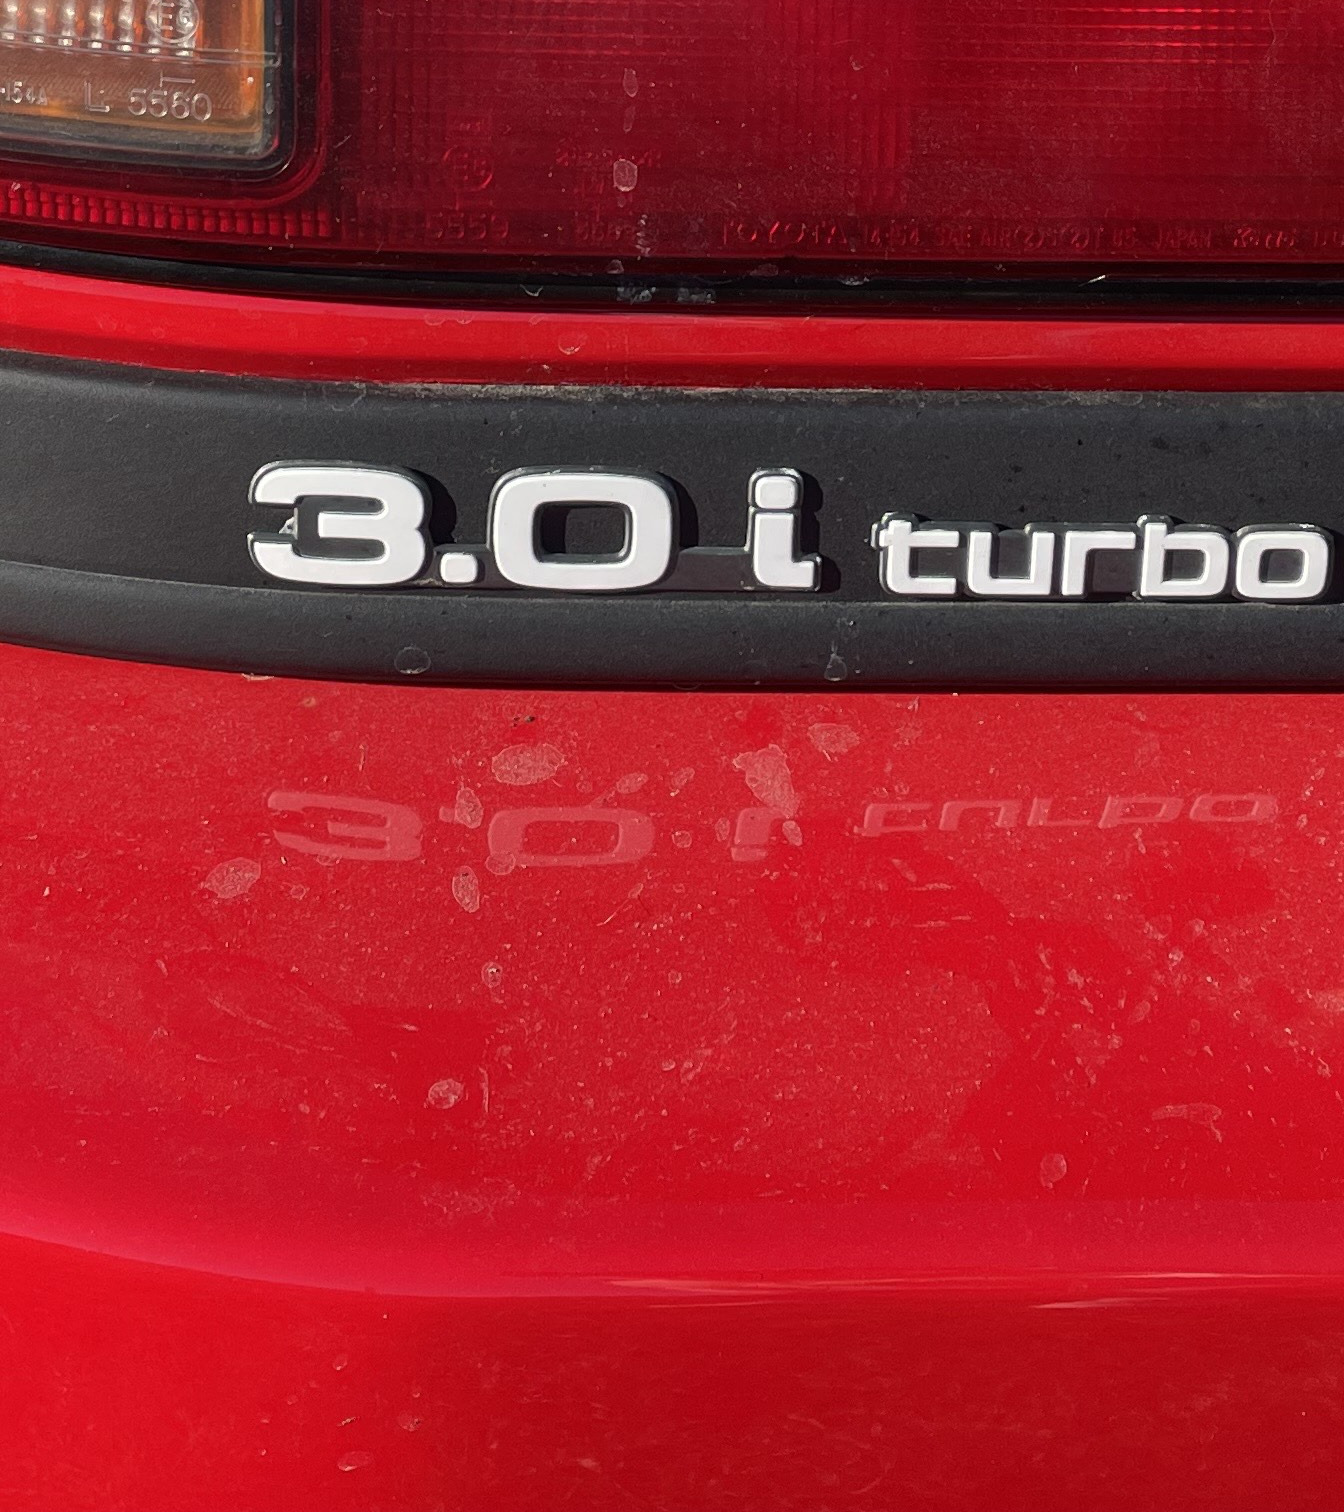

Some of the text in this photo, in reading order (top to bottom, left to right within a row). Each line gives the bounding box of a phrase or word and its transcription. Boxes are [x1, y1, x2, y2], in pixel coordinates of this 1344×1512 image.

[127, 88, 213, 123] 5560
[250, 461, 1335, 602] 3.0 i turbo
